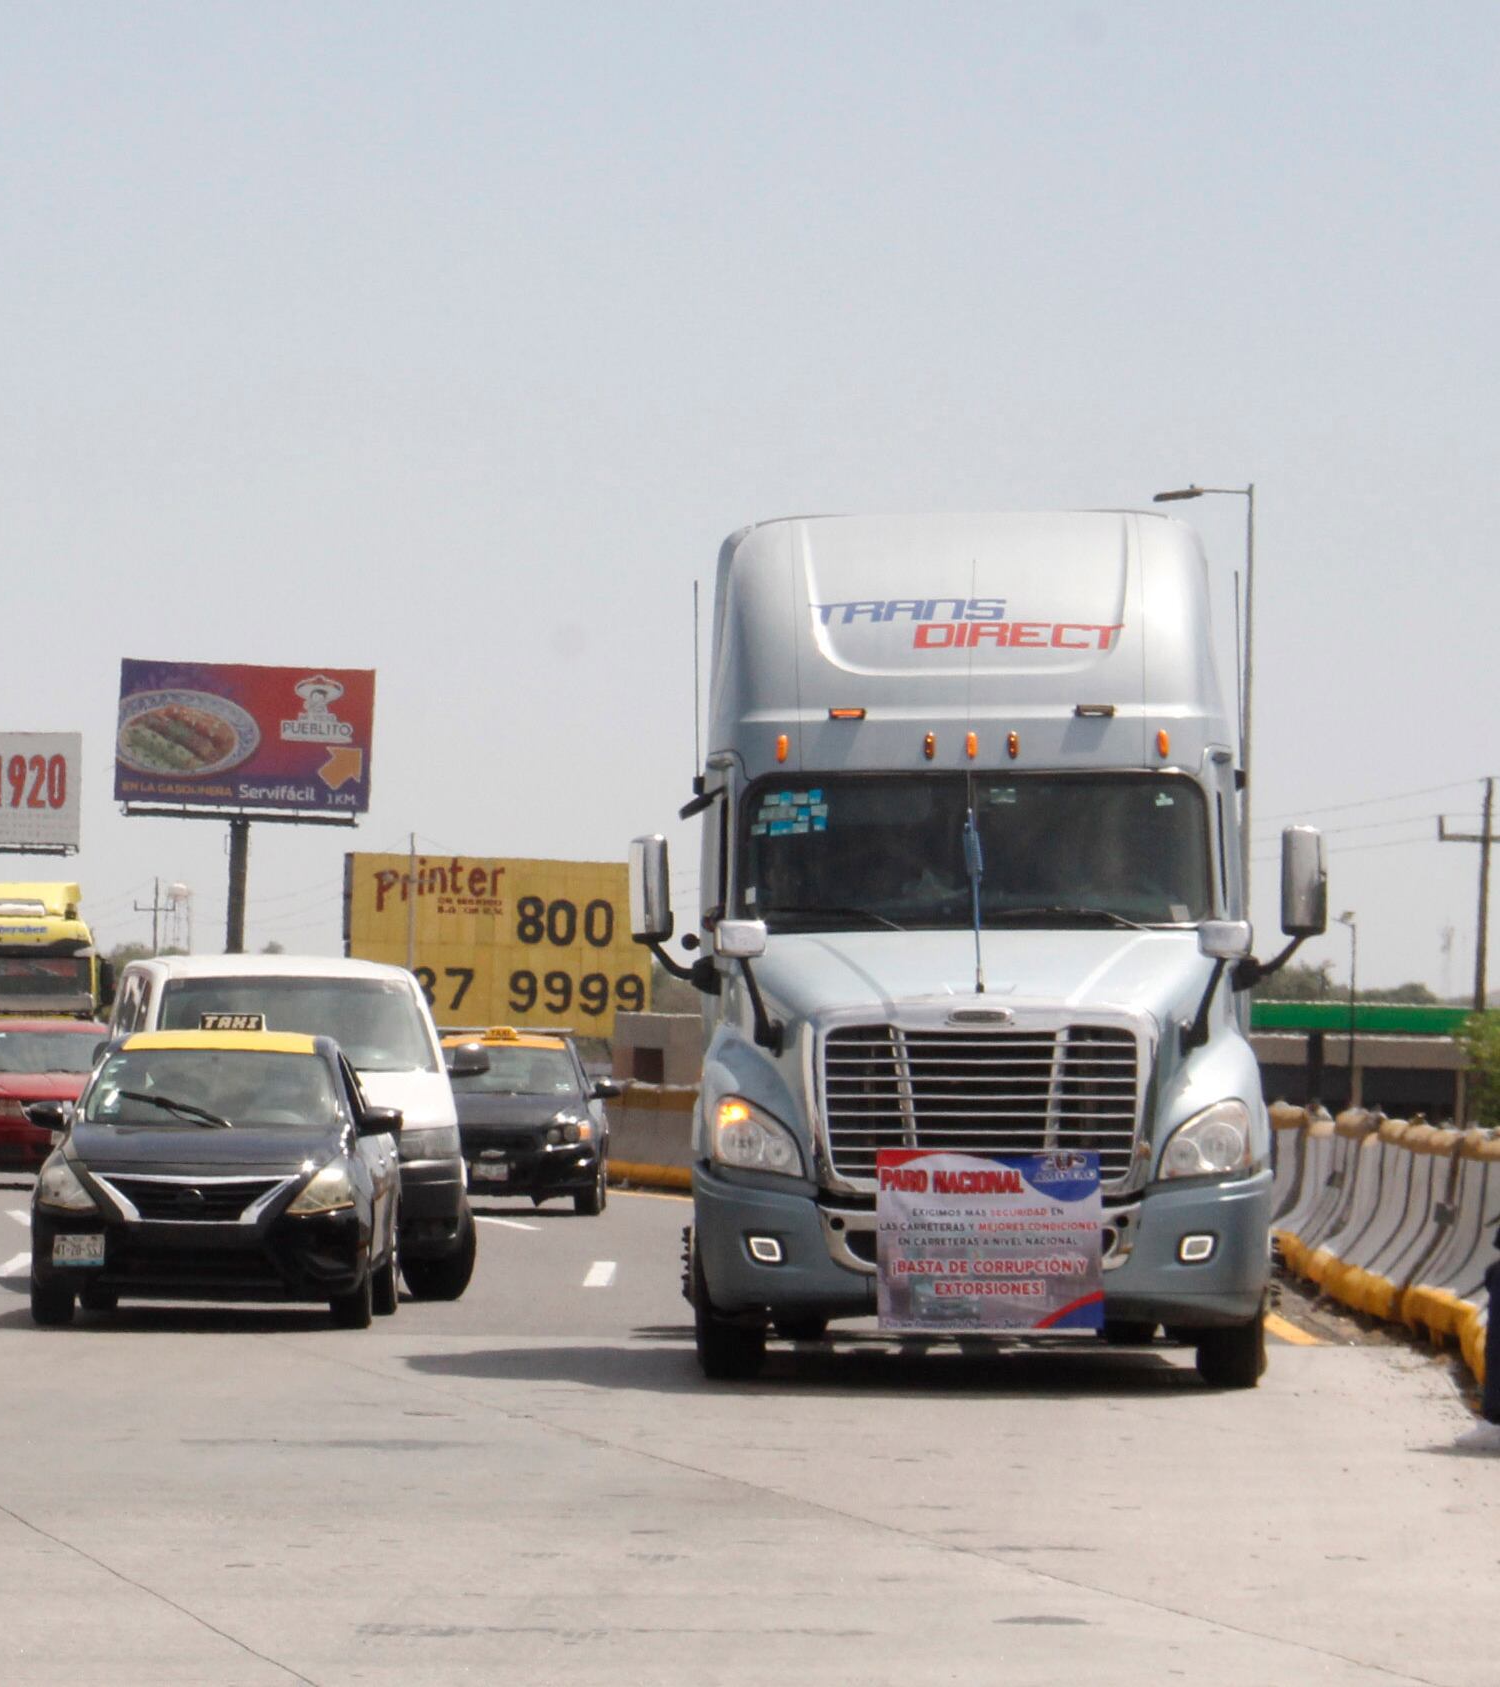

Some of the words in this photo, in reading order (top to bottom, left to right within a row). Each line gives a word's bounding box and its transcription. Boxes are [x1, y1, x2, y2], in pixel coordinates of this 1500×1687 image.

[809, 598, 1007, 625] TRANS
[913, 621, 1126, 650] DIRECT
[282, 722, 352, 737] PUEBLITO
[238, 783, 316, 802] Servifácil
[516, 896, 615, 948] 800
[508, 970, 646, 1016] 9999
[879, 1167, 928, 1192] PARO
[932, 1170, 1025, 1195] NACIONAL
[901, 1222, 964, 1232] CARRETERAS
[978, 1222, 1025, 1234] MEJORES
[1028, 1222, 1098, 1232] CONDICIONES
[914, 1237, 979, 1246] CARRETERAS
[992, 1237, 1021, 1246] NIVEL
[1026, 1236, 1079, 1246] NACIONAL
[950, 1260, 969, 1274] DE
[973, 1258, 1072, 1275] CORRUPCIÓN
[1076, 1260, 1088, 1273] Y
[934, 1280, 1046, 1296] EXTORSIONES!
